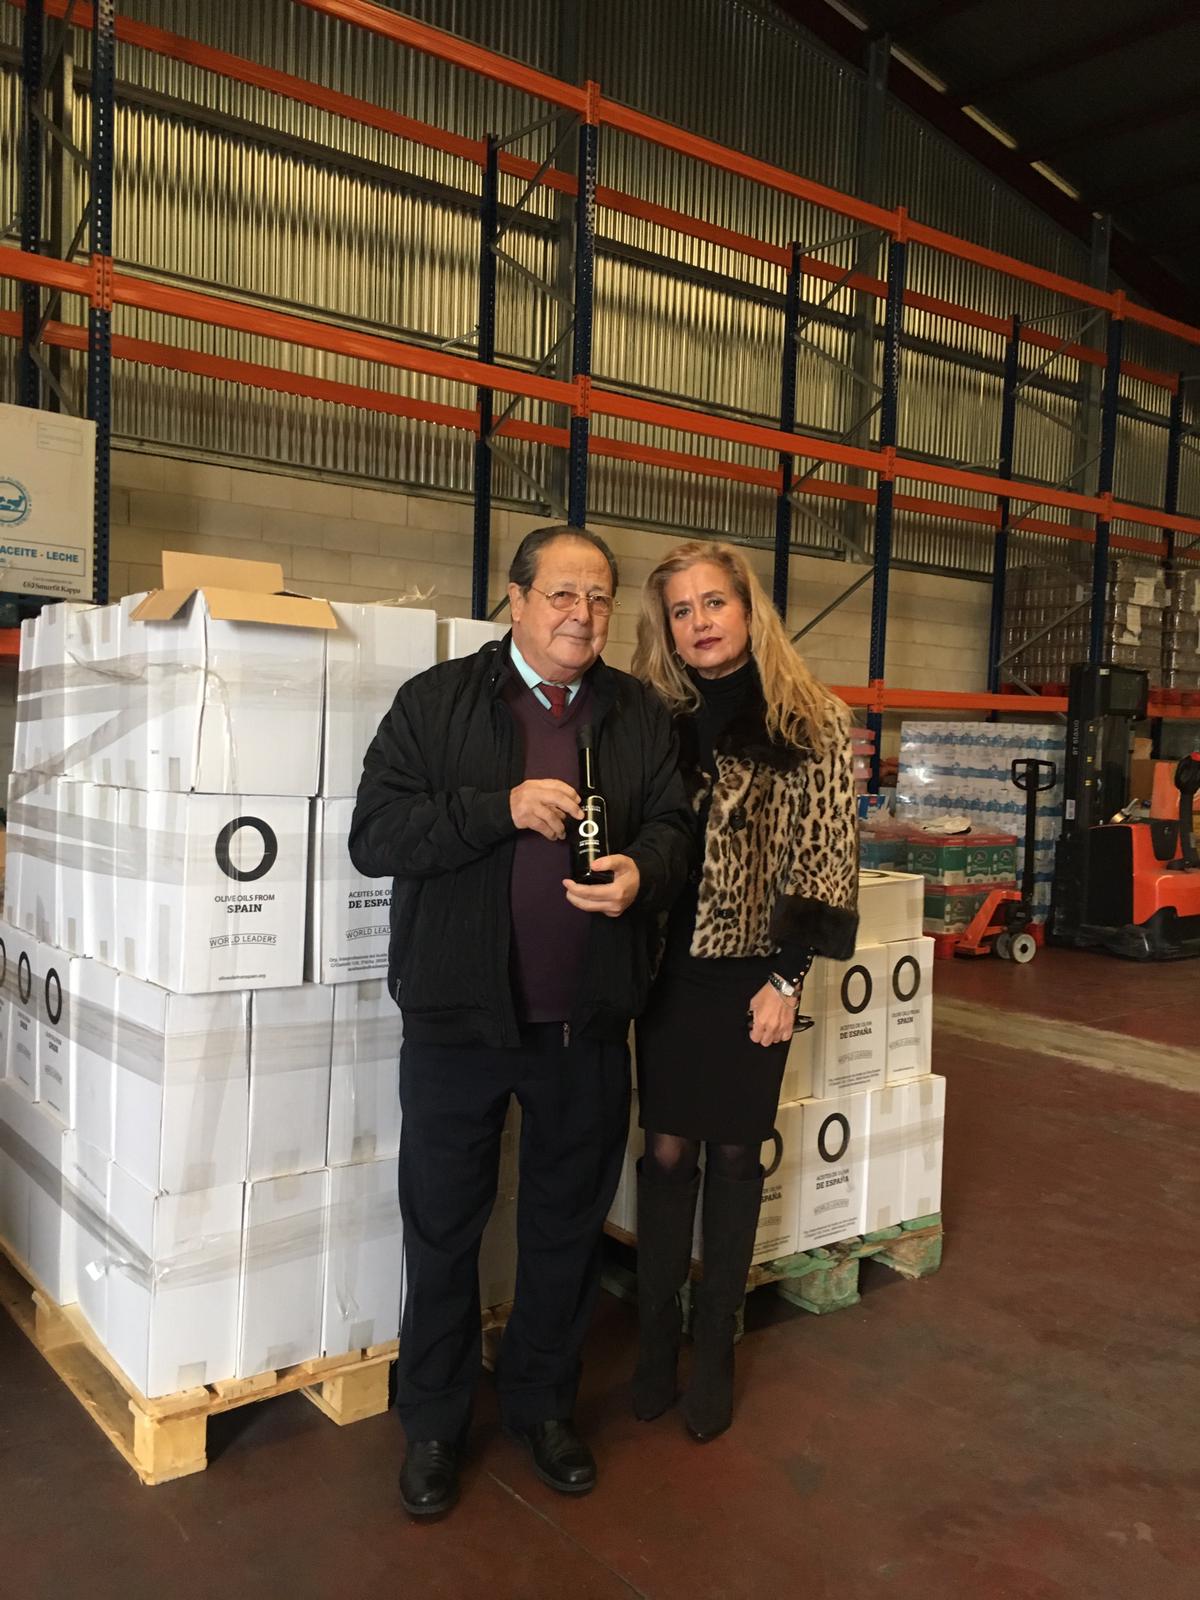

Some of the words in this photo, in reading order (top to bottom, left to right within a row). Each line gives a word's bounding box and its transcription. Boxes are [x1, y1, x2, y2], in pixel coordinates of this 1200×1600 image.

[0, 545, 37, 558] ACEITE
[46, 551, 79, 563] LECHE
[215, 815, 278, 882] O
[237, 894, 253, 902] OILS
[349, 890, 373, 898] ACEITES
[227, 903, 262, 913] SPAIN
[348, 900, 362, 909] DE
[364, 899, 392, 908] ESPA
[346, 928, 372, 938] WORLD
[374, 927, 392, 935] LEAD
[242, 935, 277, 943] LEADERS
[896, 1016, 914, 1025] SPAIN
[816, 1182, 824, 1190] DE
[761, 1191, 782, 1204] SPAÑA
